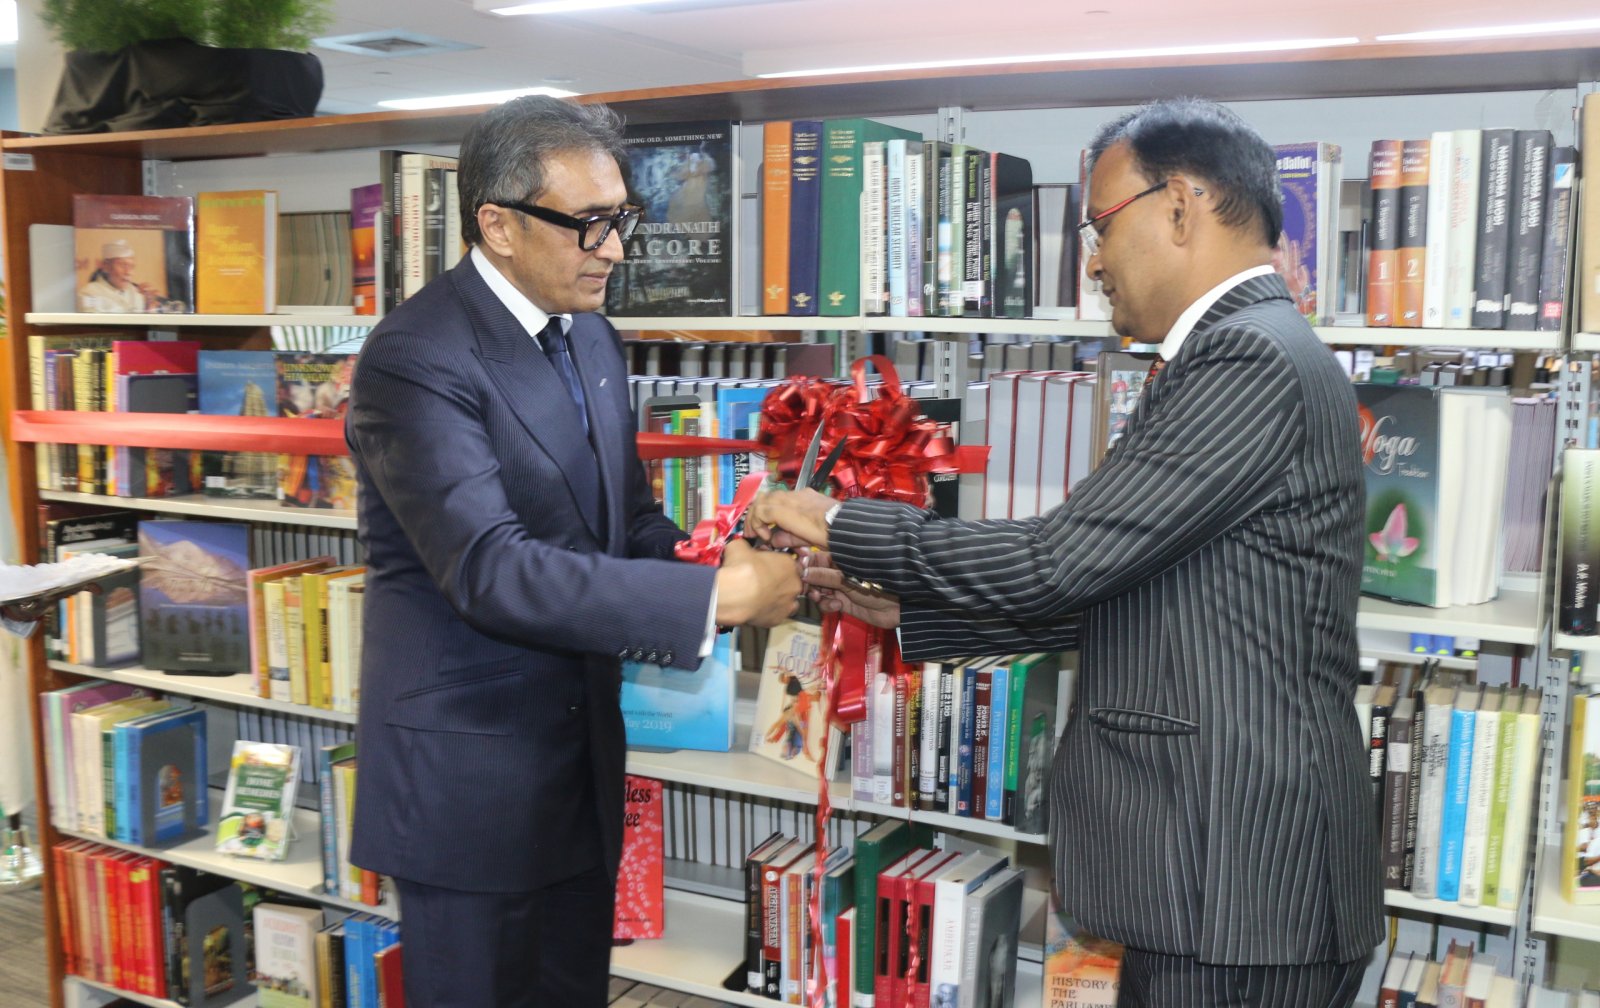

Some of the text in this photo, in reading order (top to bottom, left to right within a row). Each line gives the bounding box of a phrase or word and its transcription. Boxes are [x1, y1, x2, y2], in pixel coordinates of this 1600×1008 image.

[664, 134, 705, 142] SOMETHING
[1493, 145, 1510, 226] NARENDRA MODI
[1528, 146, 1545, 227] NARENDRA MODI
[634, 221, 721, 235] NDRANATH
[891, 177, 903, 270] INDIA'S NUCLEAR SECURITY
[629, 239, 722, 257] AGORE
[1378, 261, 1389, 280] 1
[1407, 259, 1419, 277] 2
[1360, 415, 1420, 475] Yoga
[895, 675, 904, 737] OUR CONSTITUTION
[944, 694, 952, 717] 2100
[643, 720, 672, 733] 2019
[981, 705, 989, 729] POWER
[625, 781, 652, 803] less
[624, 812, 640, 827] ee
[768, 886, 778, 948] AFGHANISTAN
[943, 919, 956, 971] AMBEDKAR
[1052, 975, 1108, 990] HISTORY
[1051, 987, 1078, 999] THE
[1051, 999, 1113, 1008] PARLIAME
